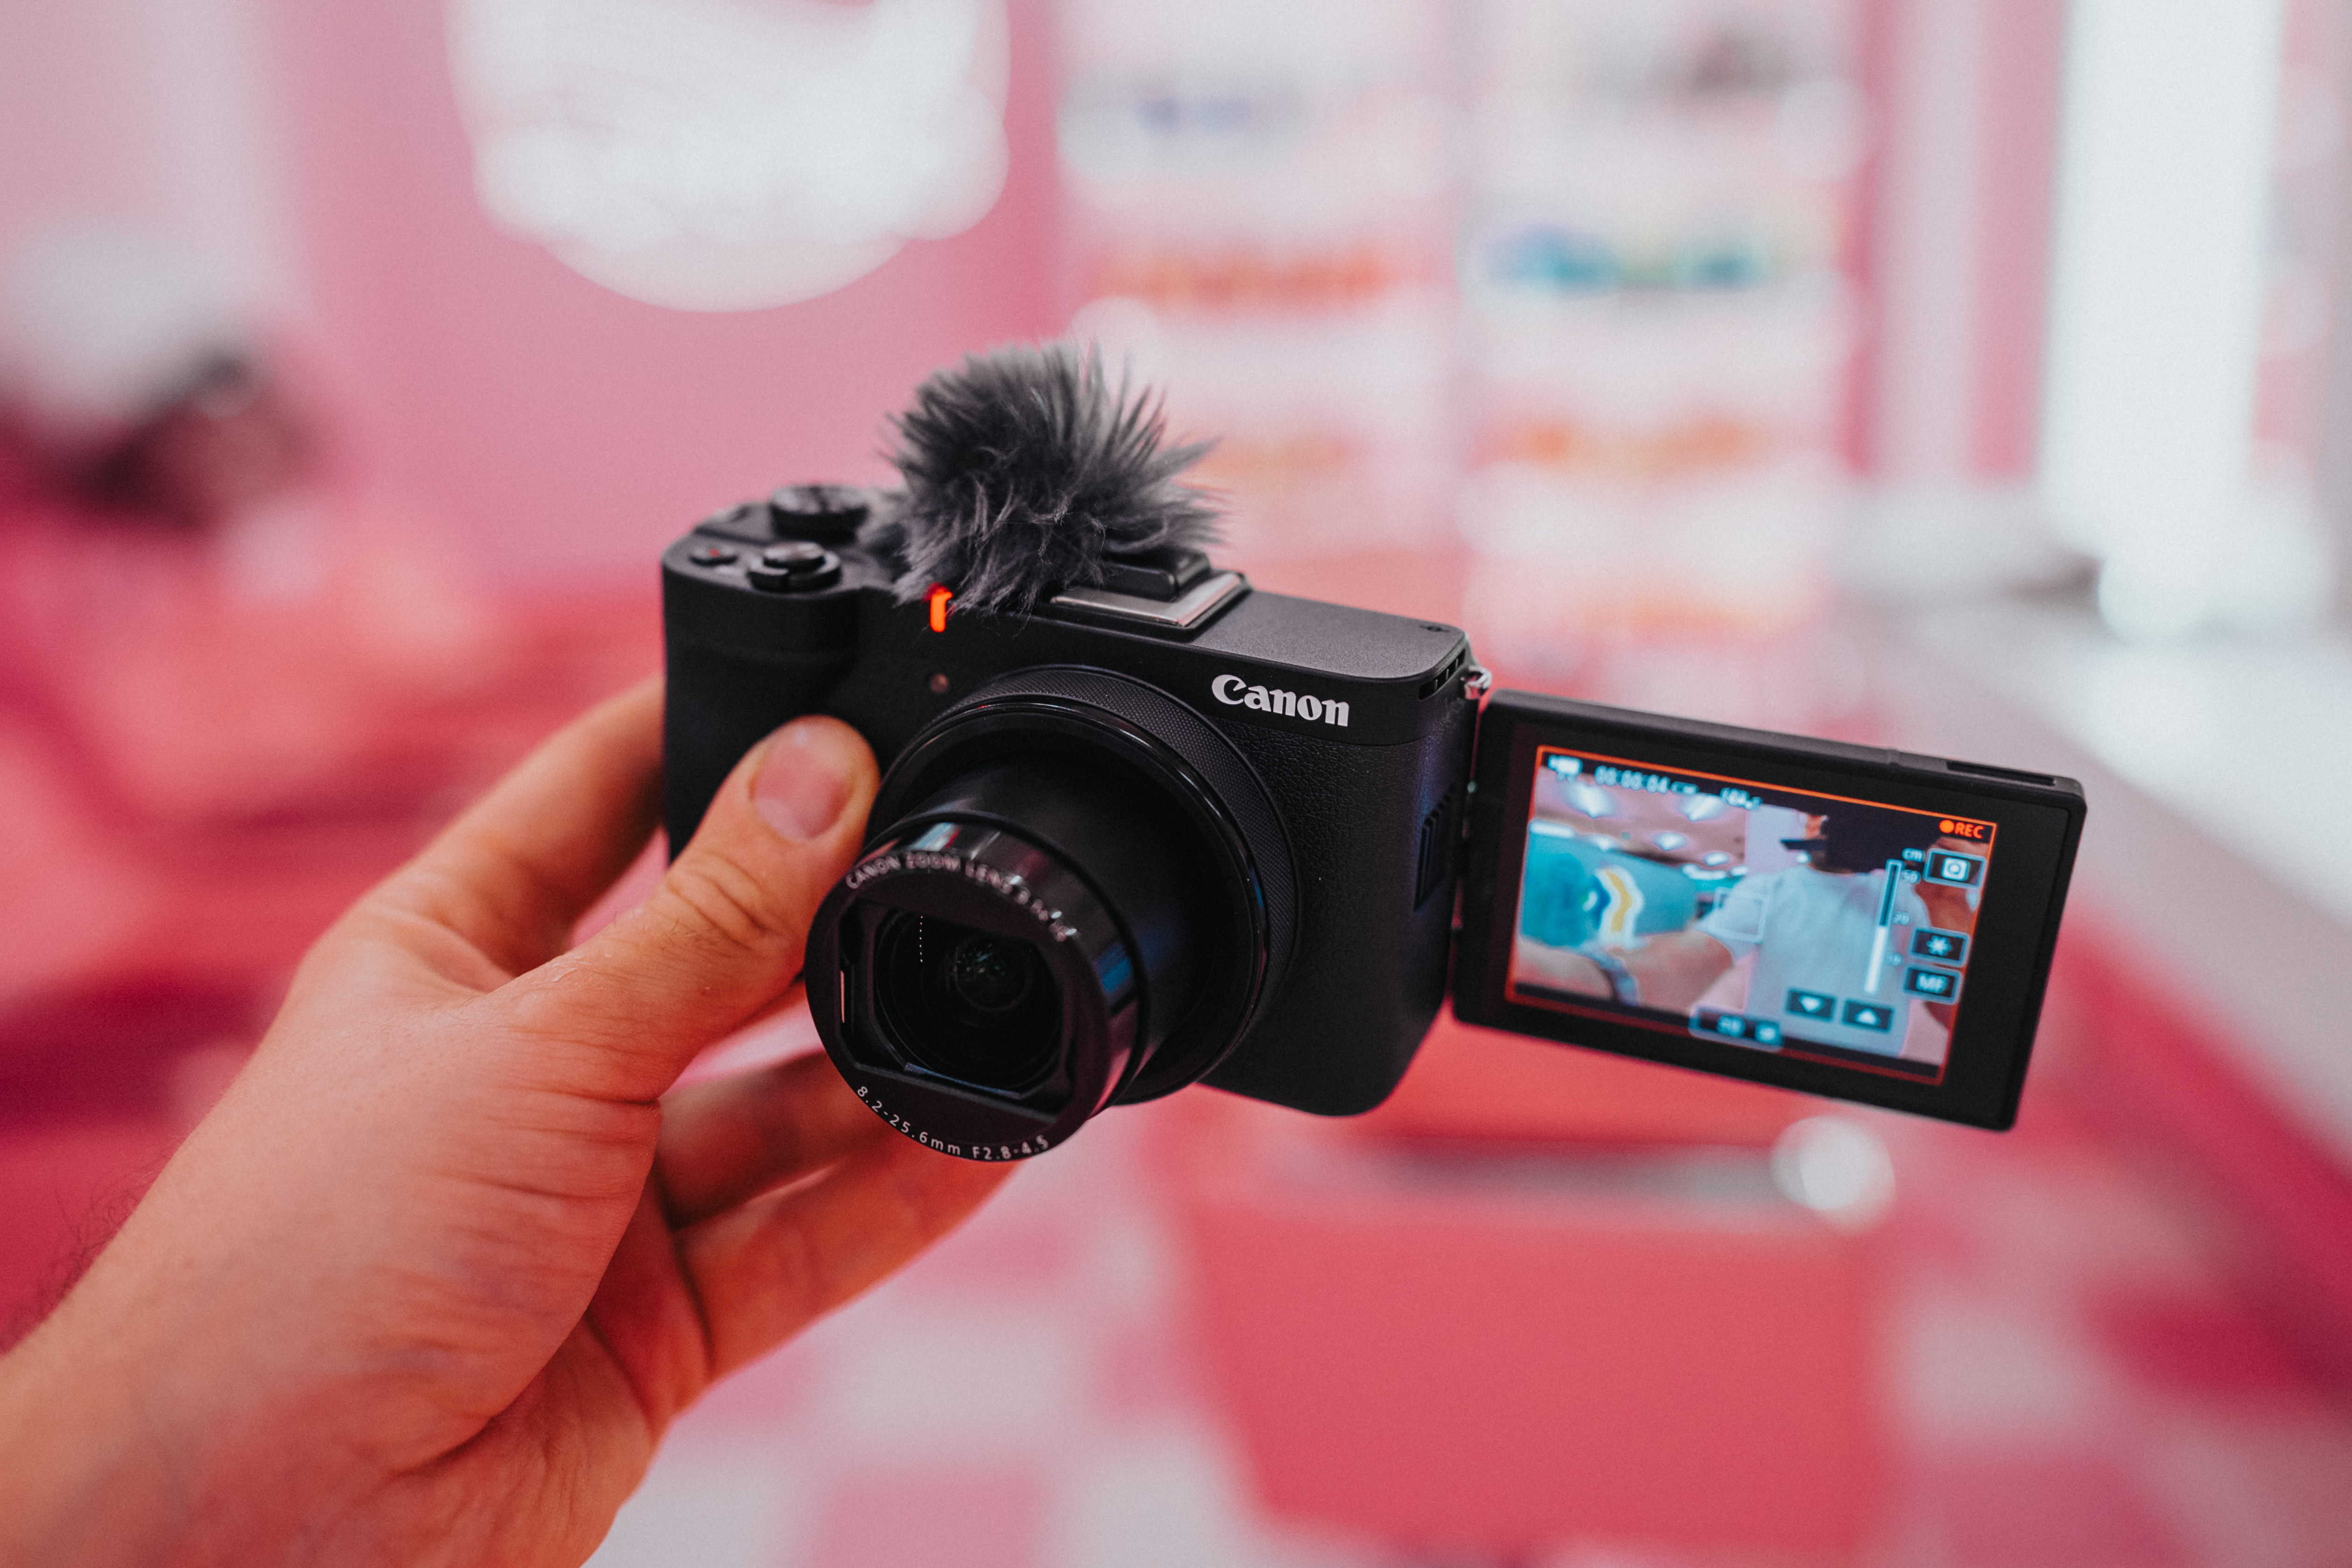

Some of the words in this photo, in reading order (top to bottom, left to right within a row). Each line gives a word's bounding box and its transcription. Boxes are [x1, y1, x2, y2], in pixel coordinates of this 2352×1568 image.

[1212, 675, 1349, 727] Canon
[1954, 822, 1985, 839] REC
[846, 855, 901, 889] CANON
[906, 851, 961, 872] ZOOM
[1902, 848, 1925, 863] cm
[1916, 971, 1948, 994] MF
[857, 1086, 961, 1156] 8.2-25.6mm
[972, 1134, 1049, 1161] F2.8-4.5
